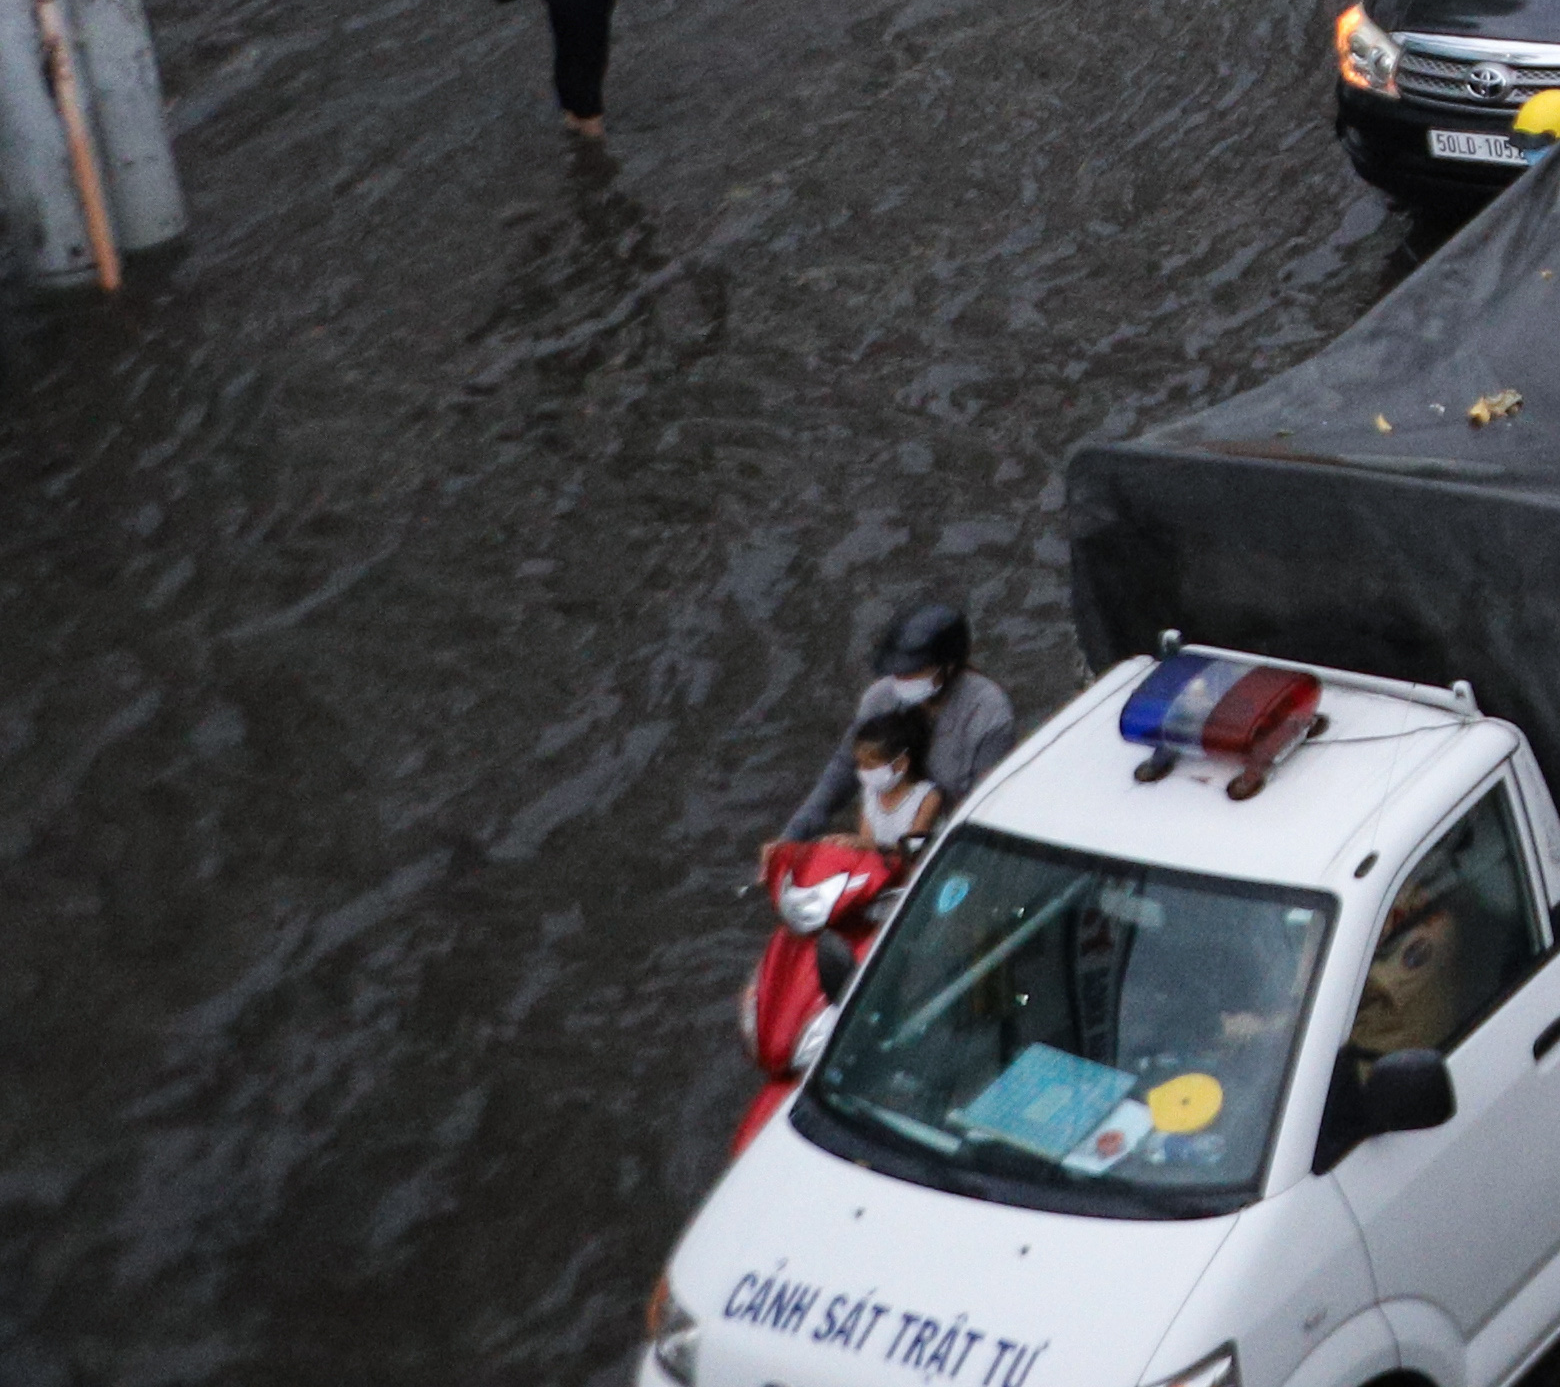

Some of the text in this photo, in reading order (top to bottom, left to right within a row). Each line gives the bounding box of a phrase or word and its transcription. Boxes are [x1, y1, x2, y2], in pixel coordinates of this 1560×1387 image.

[723, 1258, 821, 1334] CẢNH
[812, 1286, 890, 1352] SÁT
[884, 1311, 985, 1385] TRẬT
